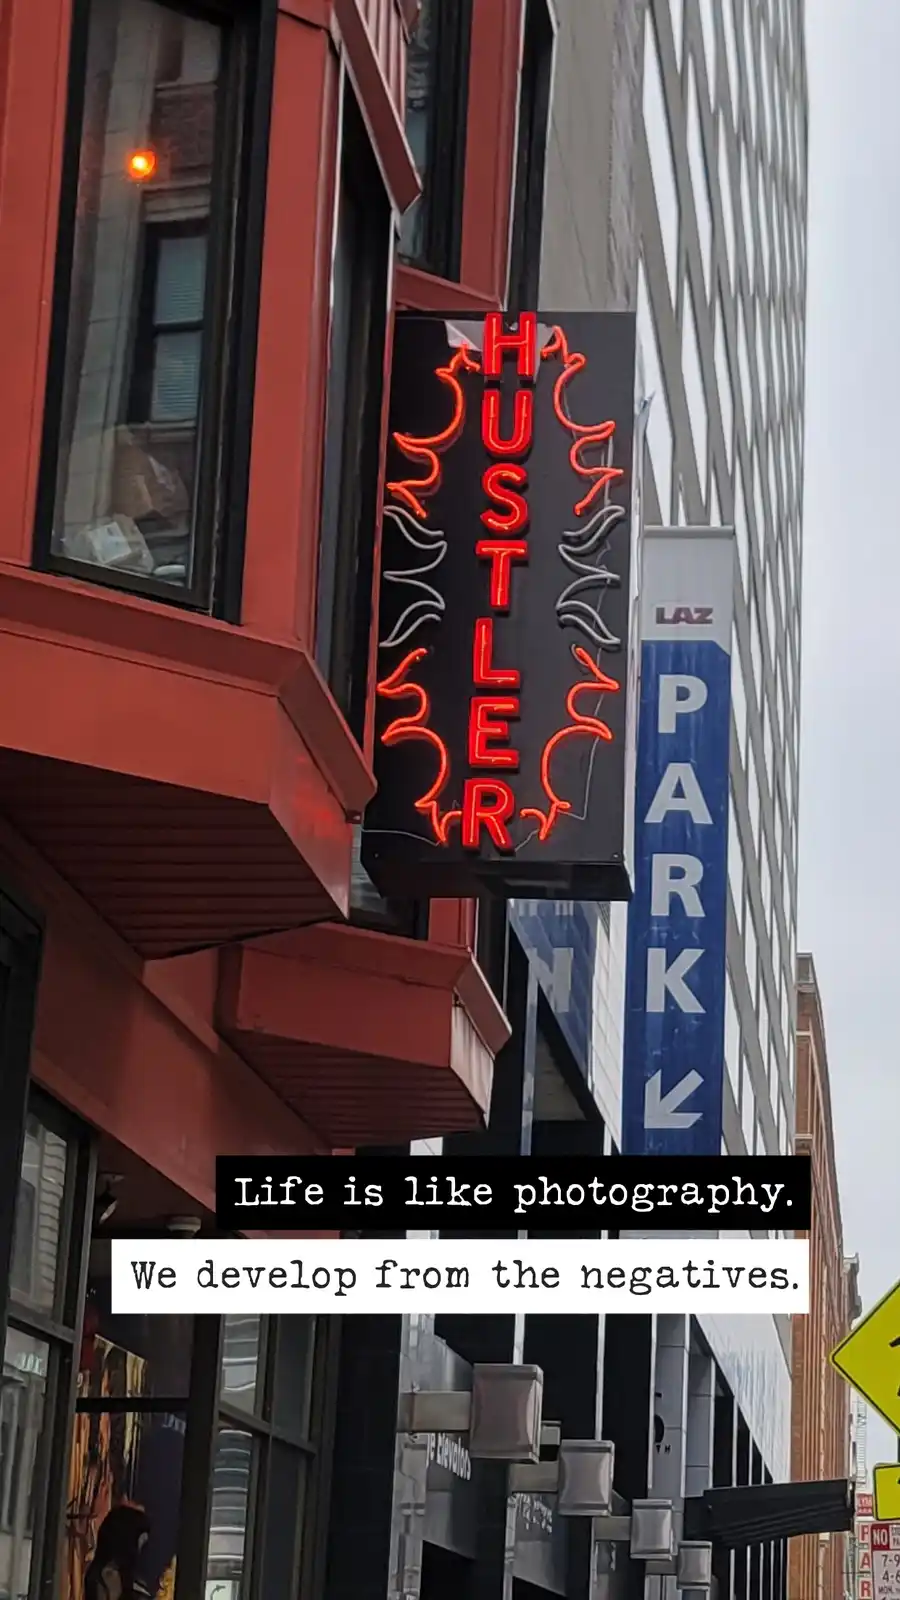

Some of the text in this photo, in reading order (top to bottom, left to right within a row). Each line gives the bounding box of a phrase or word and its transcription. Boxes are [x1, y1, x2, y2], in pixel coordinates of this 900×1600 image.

[462, 311, 536, 850] HUSTLER
[656, 607, 713, 625] LAZ
[644, 674, 713, 1014] PARK
[872, 1528, 888, 1546] NO
